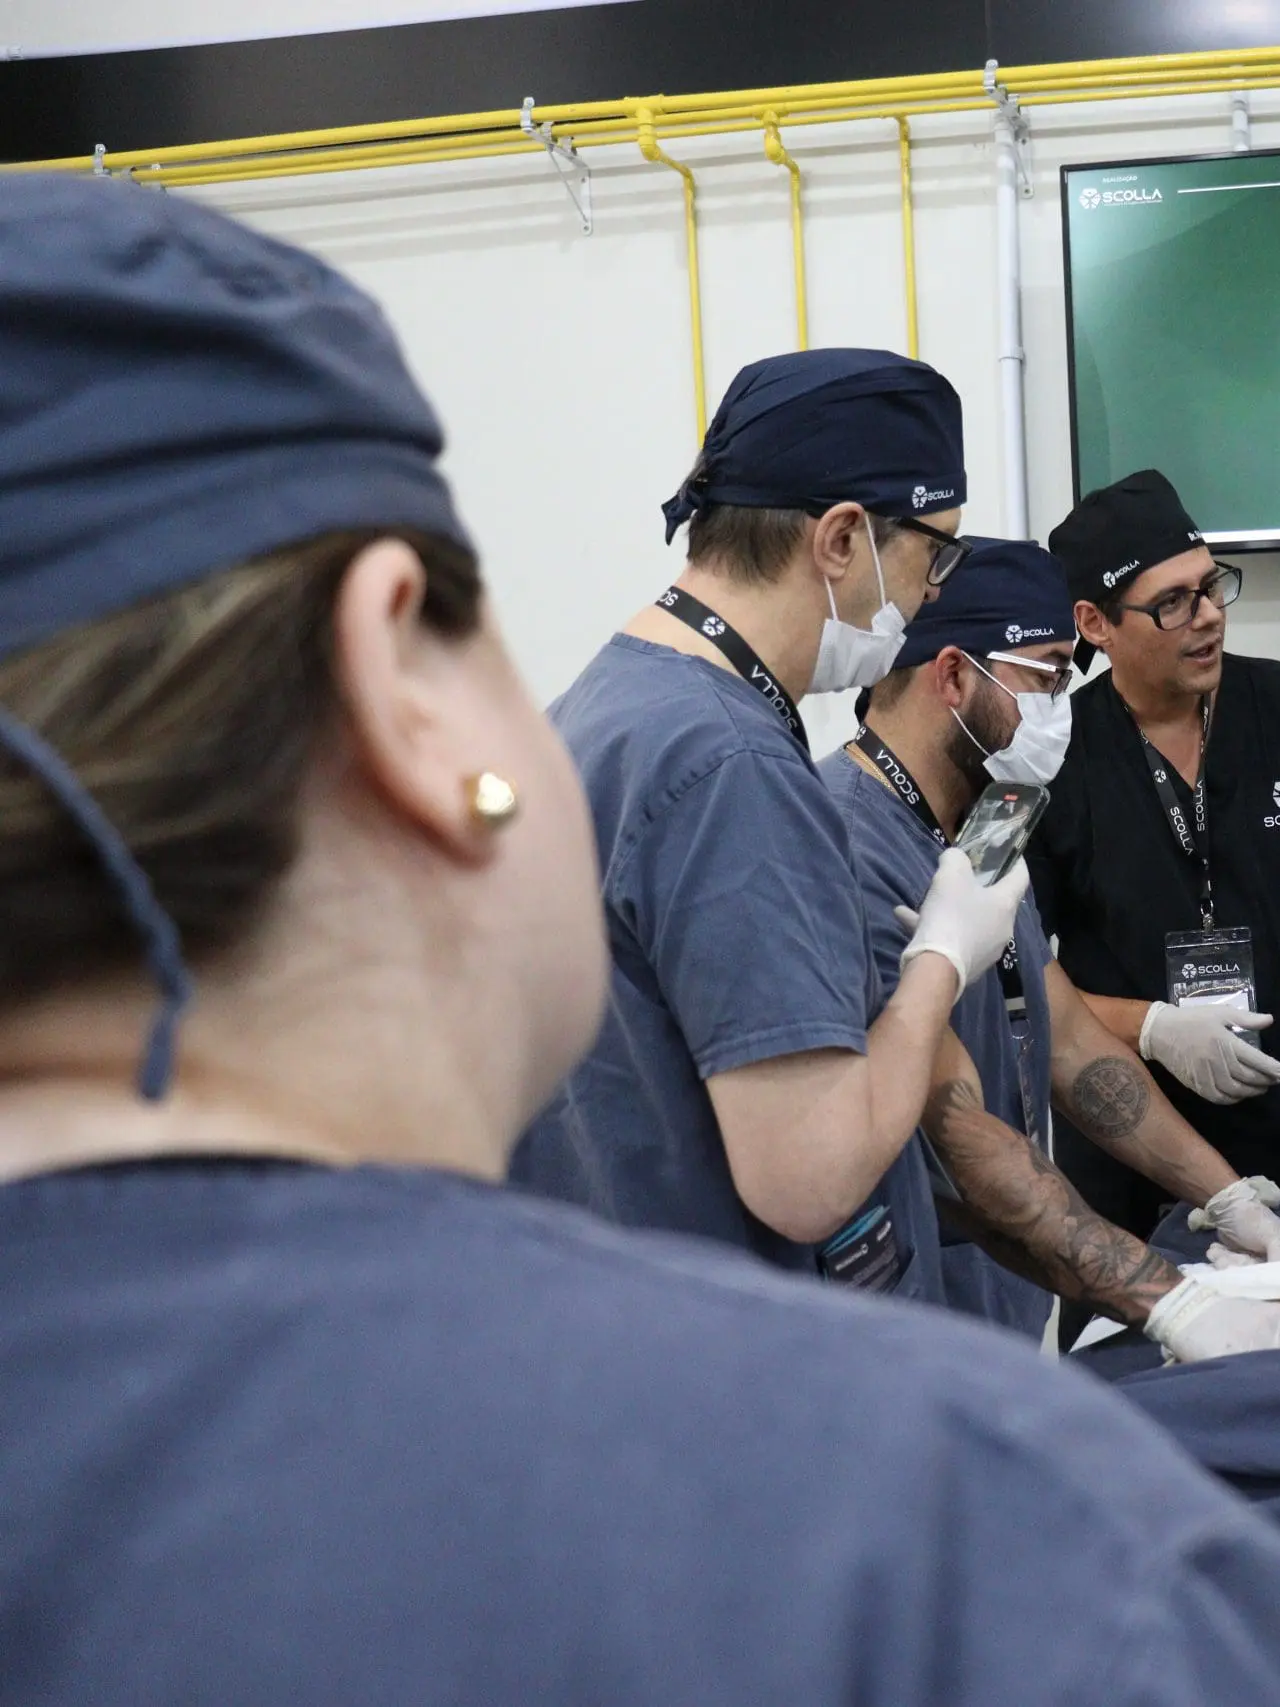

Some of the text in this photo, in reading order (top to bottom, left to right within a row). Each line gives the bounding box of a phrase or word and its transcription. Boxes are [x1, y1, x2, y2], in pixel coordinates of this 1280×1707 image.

[1102, 188, 1163, 203] SCOLLA
[928, 489, 954, 501] SCOLLA
[1114, 559, 1140, 579] SCOLLA
[1023, 628, 1055, 637] SCOLLA
[751, 665, 798, 730] SCOLLA
[876, 749, 920, 805] SCOLLA
[1196, 778, 1205, 832] SCOLLA
[1170, 806, 1194, 856] SCOLLA
[1198, 963, 1240, 974] SCOLLA
